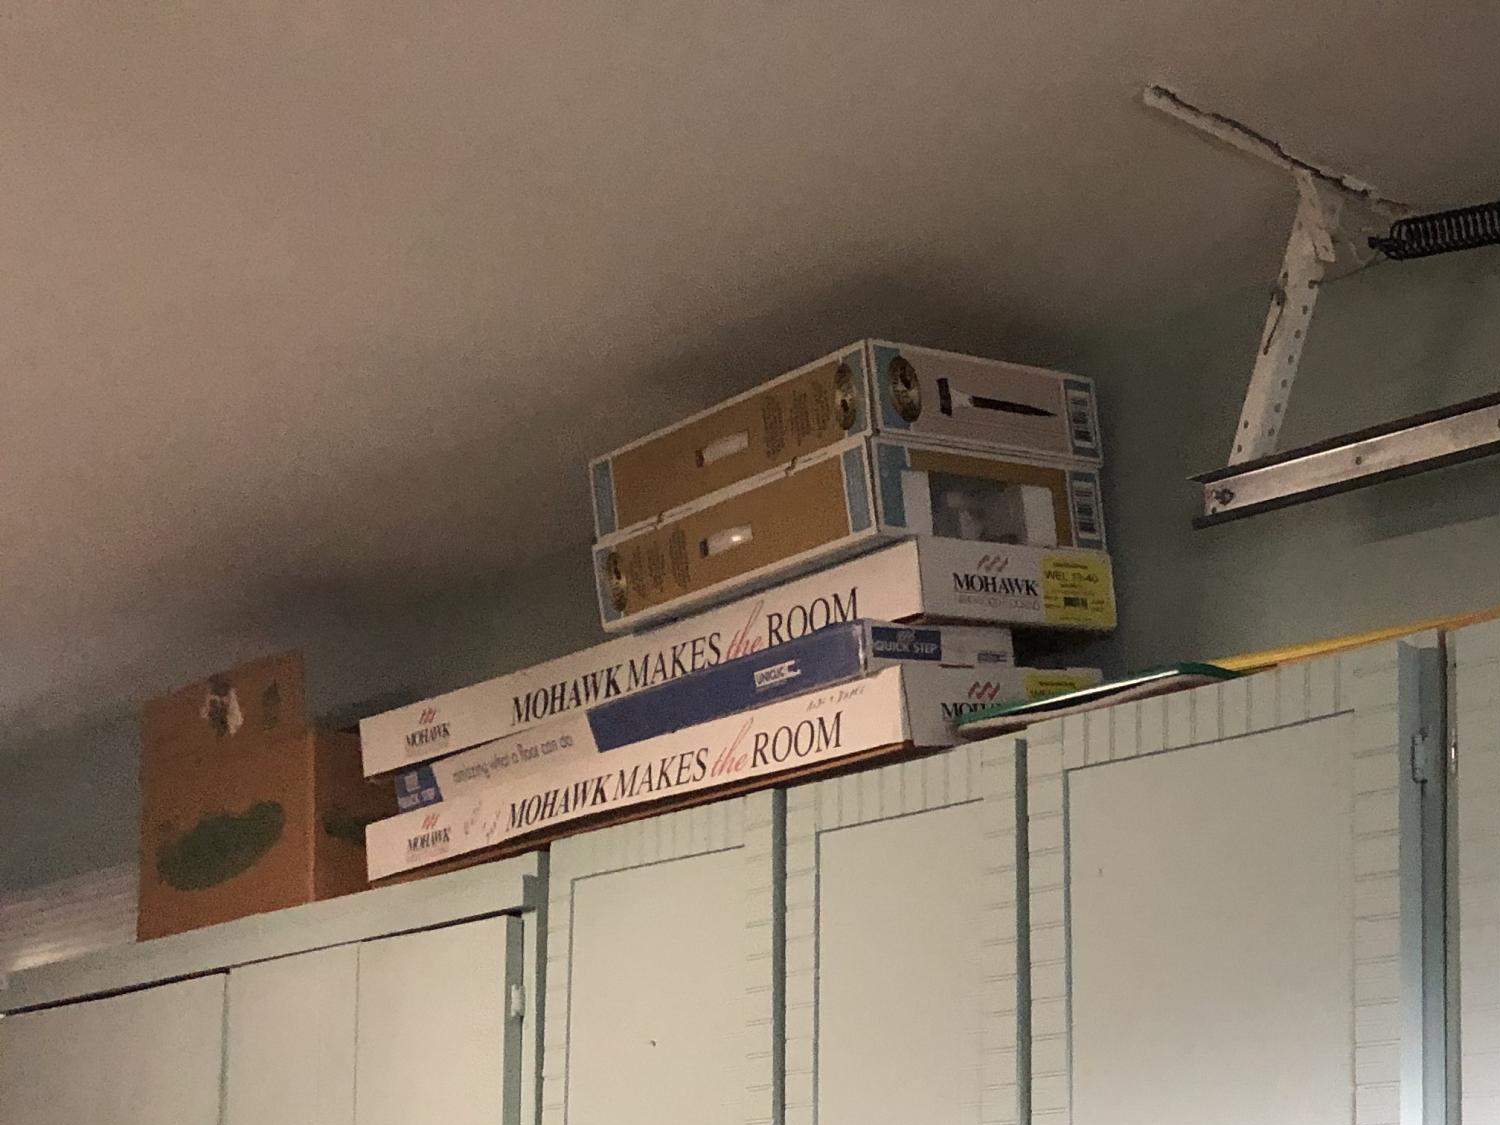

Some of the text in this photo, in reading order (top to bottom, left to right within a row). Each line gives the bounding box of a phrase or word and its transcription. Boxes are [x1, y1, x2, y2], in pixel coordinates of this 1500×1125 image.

[952, 572, 1039, 596] MOHAWK
[511, 586, 858, 727] MOHAWK MAKES the ROOM
[874, 640, 938, 654] QUICK STEP
[405, 722, 451, 747] MOHAWK
[505, 773, 613, 832] MOHAWK
[613, 748, 710, 800] MAKES
[710, 716, 754, 778] the
[751, 711, 843, 768] ROOM
[408, 827, 451, 851] MOHAWK
